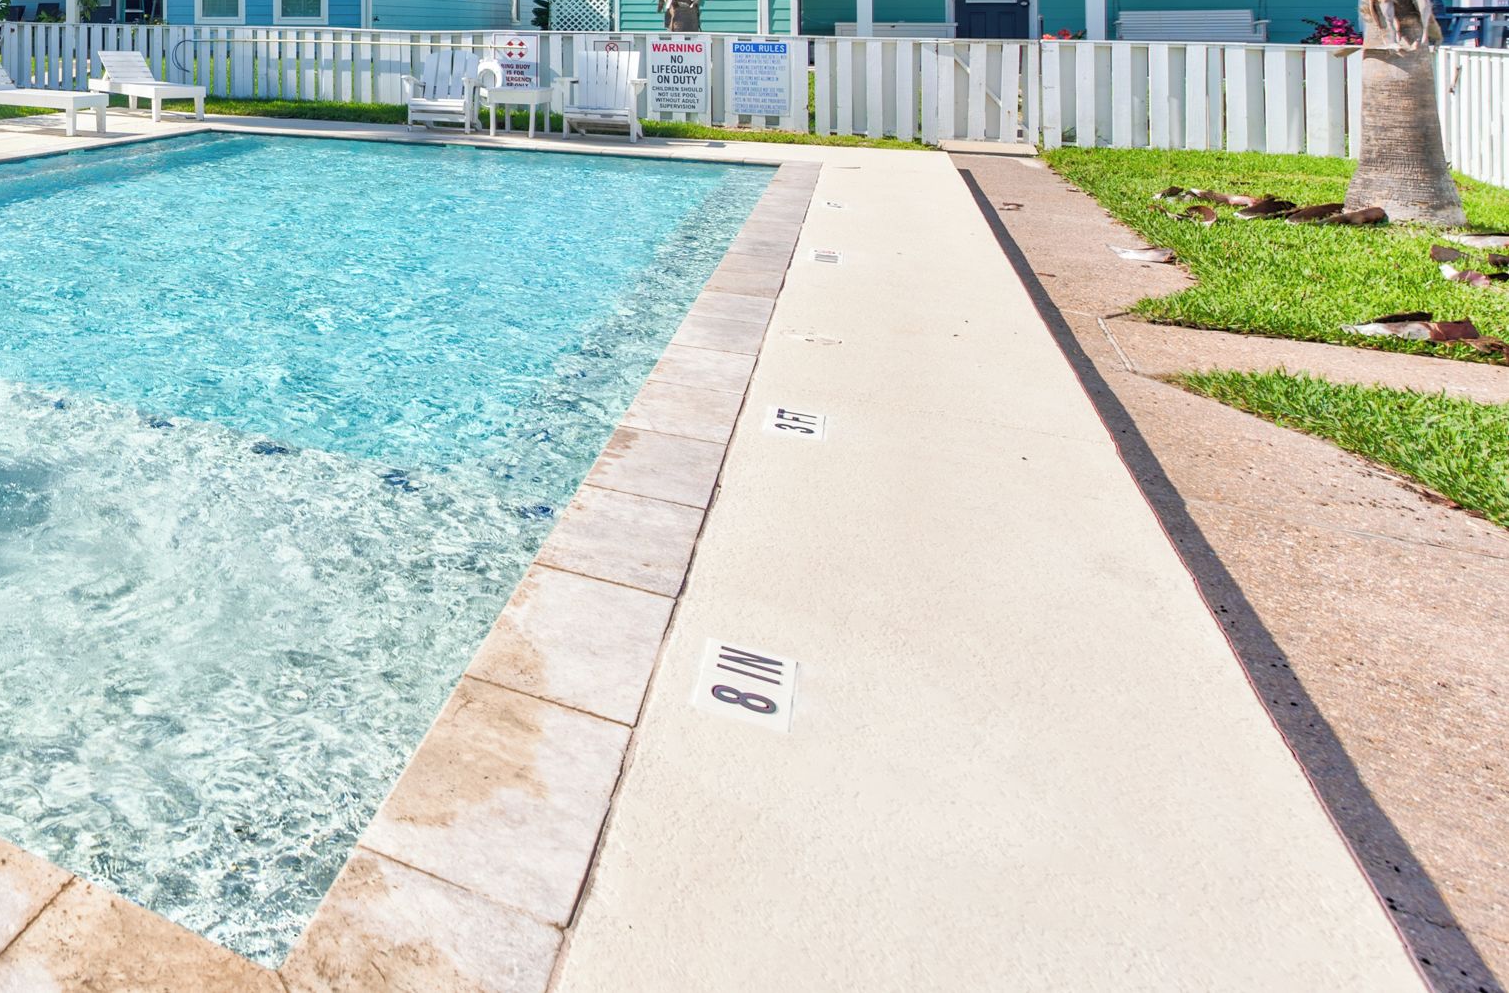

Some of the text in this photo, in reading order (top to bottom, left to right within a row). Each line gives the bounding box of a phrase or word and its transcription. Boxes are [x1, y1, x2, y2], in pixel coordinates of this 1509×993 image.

[652, 43, 703, 53] WARNING
[758, 44, 785, 53] RULES
[670, 55, 684, 64] NO
[652, 65, 703, 74] LIFEGUARD
[657, 75, 698, 84] ON DUTY
[712, 646, 783, 714] 8 IN
